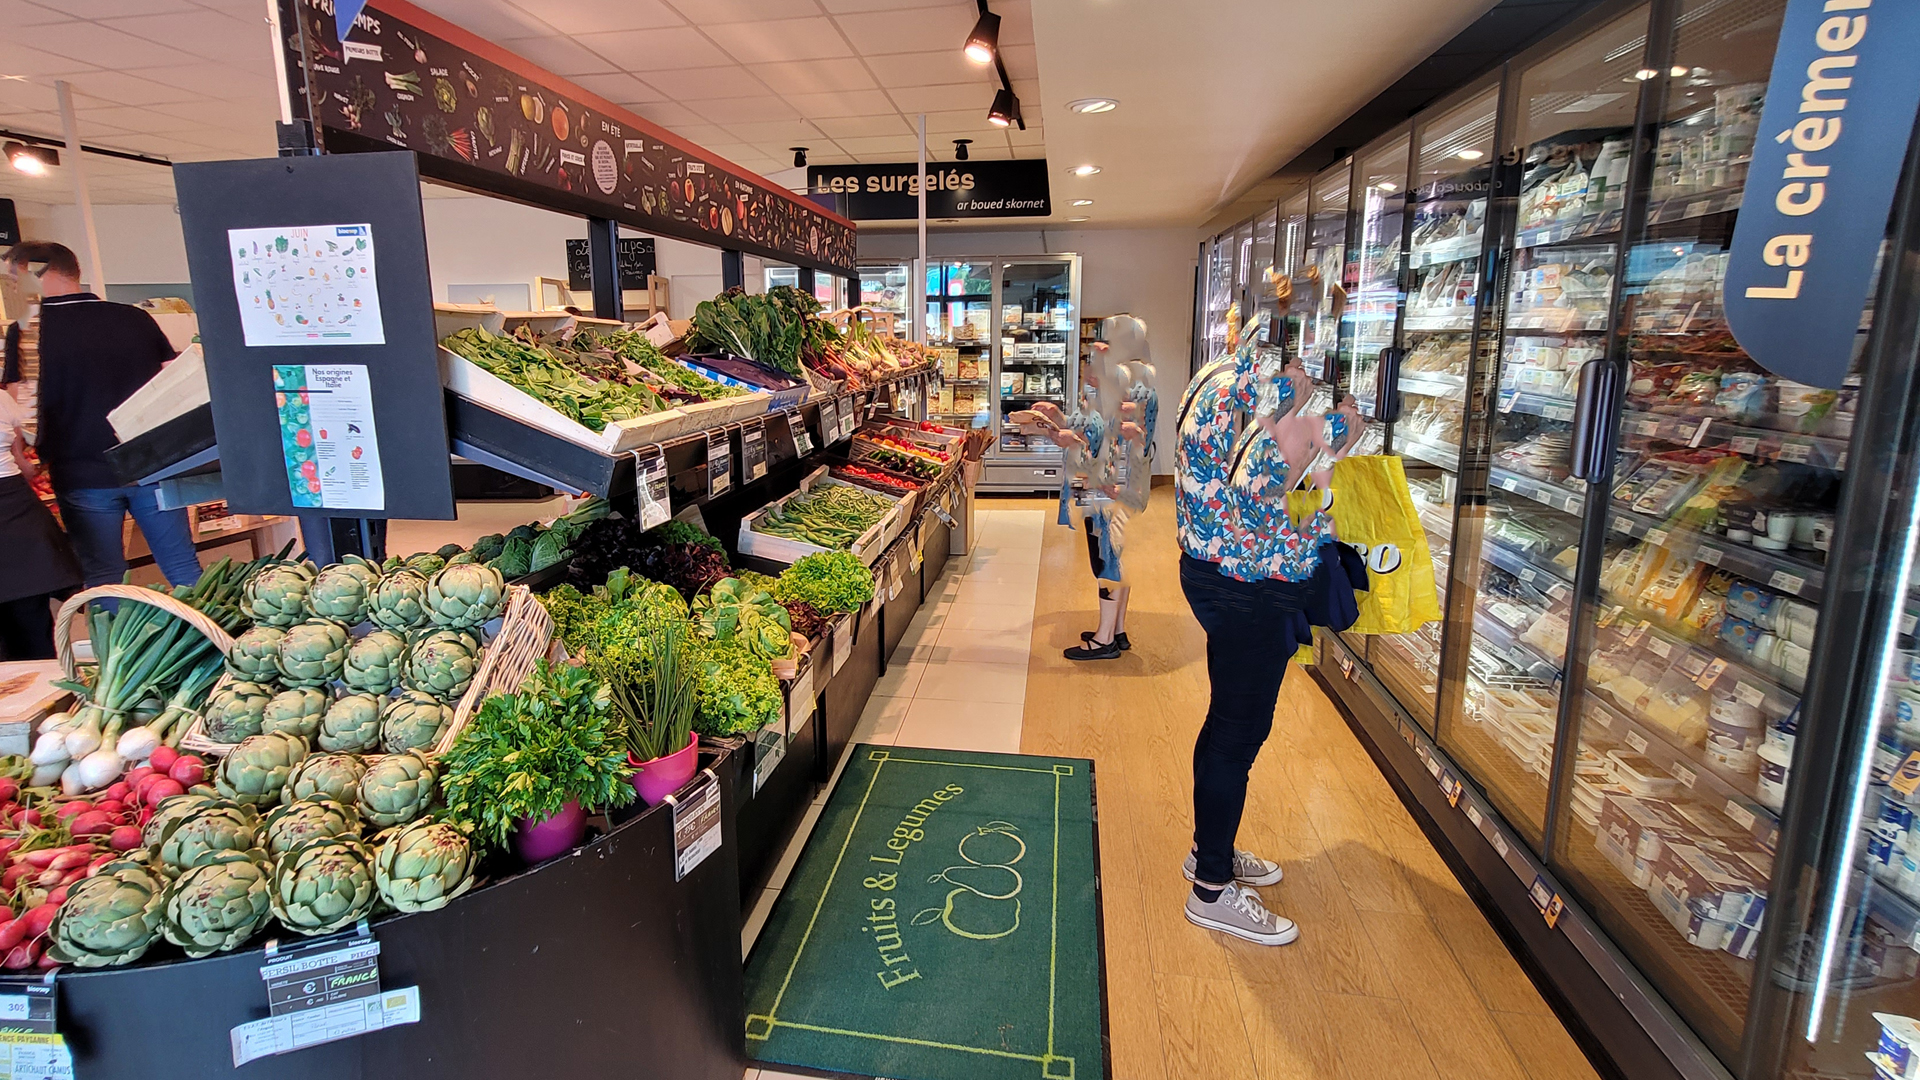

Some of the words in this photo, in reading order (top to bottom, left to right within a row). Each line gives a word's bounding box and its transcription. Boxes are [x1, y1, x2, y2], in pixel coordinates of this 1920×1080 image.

[312, 0, 381, 35] PRIMPS
[601, 120, 610, 134] EN
[610, 122, 621, 138] ÉTÉ
[470, 130, 480, 160] CAROTTE
[817, 174, 859, 194] Les
[866, 168, 975, 196] surgelés
[957, 201, 968, 211] ar
[970, 199, 1003, 211] boued
[1005, 198, 1045, 210] skornet
[290, 229, 309, 238] JUIN
[1744, 233, 1813, 300] La
[312, 368, 326, 376] Nos
[326, 368, 353, 378] origines
[315, 375, 343, 383] Espagne
[870, 781, 965, 866] Legumes
[863, 871, 898, 892] &
[862, 897, 923, 991] Fruits
[263, 962, 300, 978] PERSIL
[301, 956, 338, 970] BOTTE
[267, 953, 293, 964] PRODUIT
[330, 968, 378, 989] FRANCE
[8, 1003, 25, 1012] 302
[17, 1036, 50, 1044] PAYSANNE
[15, 1066, 48, 1074] ARTICHAUT
[48, 1065, 71, 1075] CAMUS
